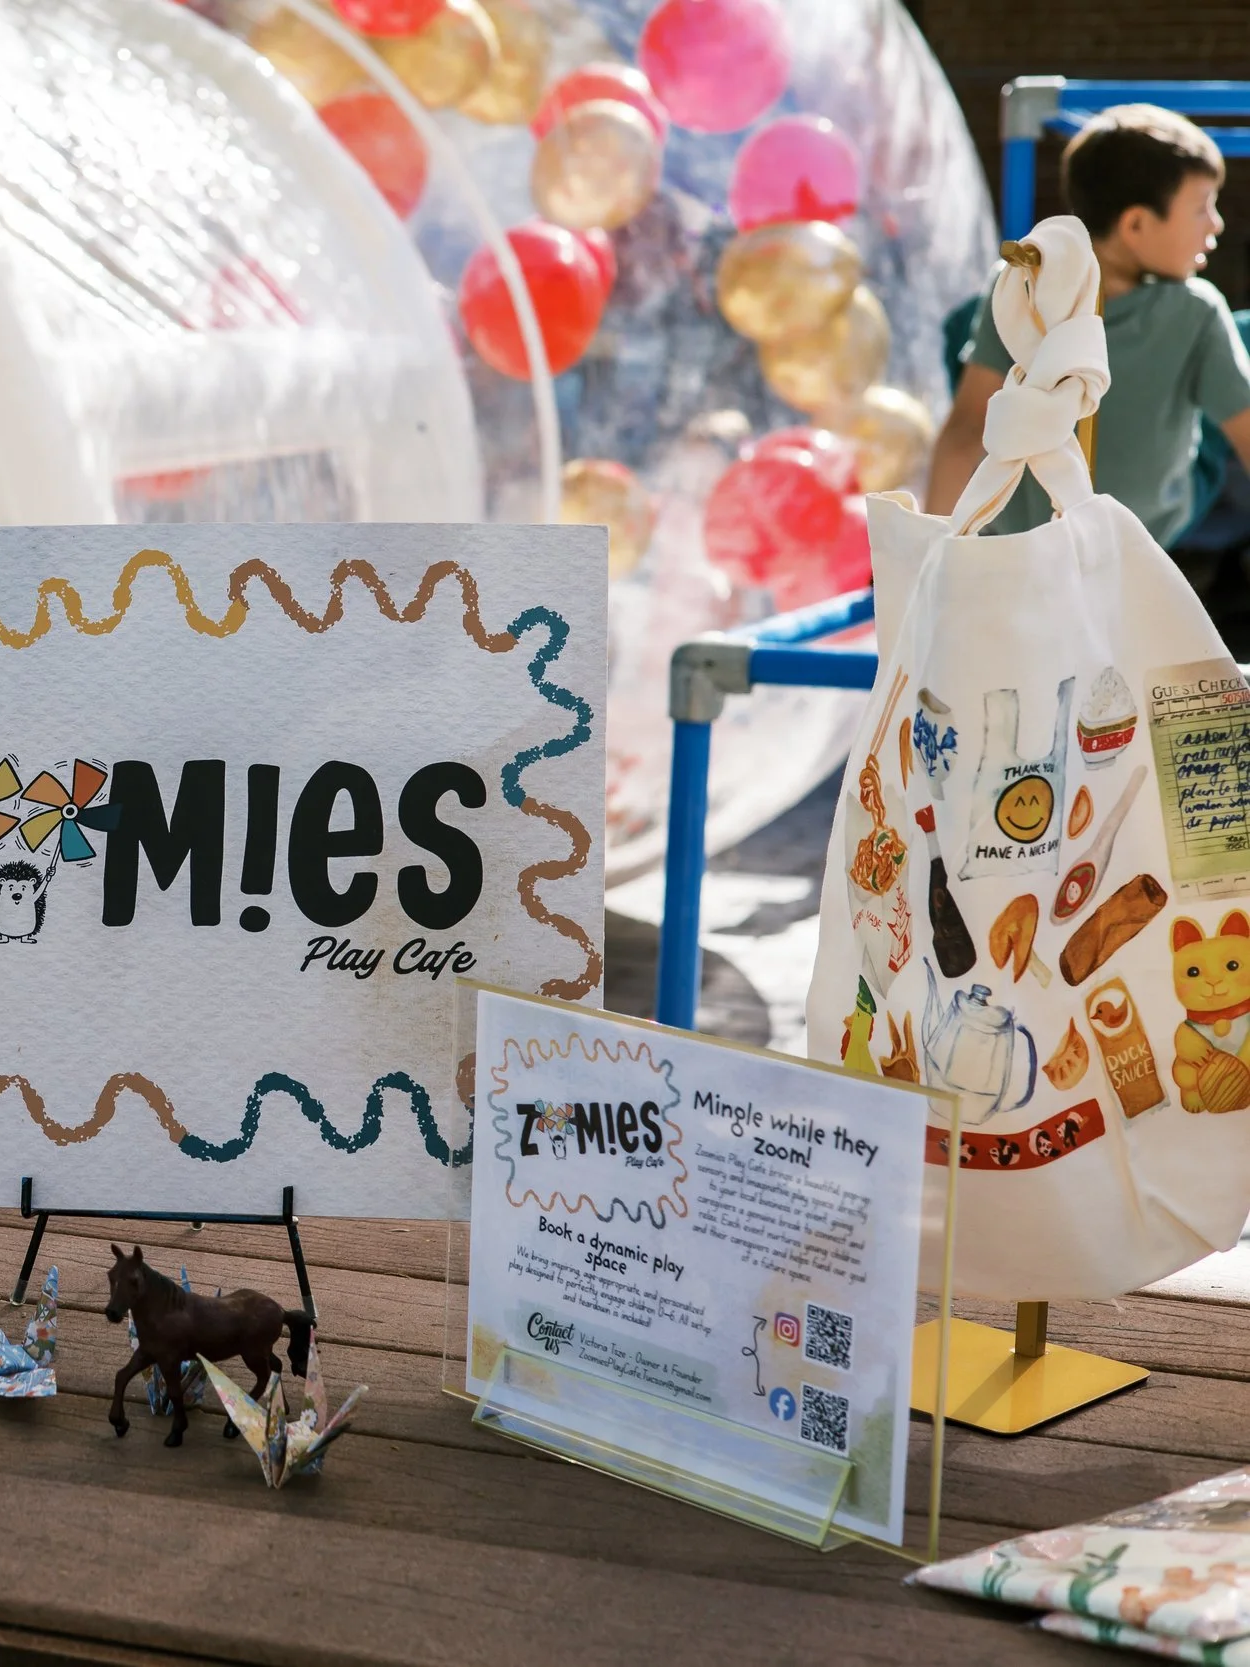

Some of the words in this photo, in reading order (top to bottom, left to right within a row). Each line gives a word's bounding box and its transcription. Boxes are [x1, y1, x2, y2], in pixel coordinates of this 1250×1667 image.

[1004, 763, 1041, 781] THANK
[975, 844, 1013, 859] HAVE
[1017, 846, 1026, 858] A
[1029, 842, 1046, 857] NICE
[300, 935, 386, 980] Play
[392, 937, 477, 981] Cafe
[1106, 1041, 1149, 1072] DUCK
[1112, 1057, 1155, 1090] SAUCE
[693, 1090, 763, 1138] Mingle
[770, 1113, 826, 1145] while
[832, 1125, 879, 1168] they
[753, 1136, 812, 1168] zoom!
[538, 1215, 573, 1242] Book
[577, 1233, 585, 1244] a
[589, 1232, 649, 1264] dynamic
[652, 1253, 684, 1282] play
[584, 1252, 627, 1275] space
[508, 1258, 524, 1276] play
[525, 1262, 555, 1282] designed
[556, 1275, 564, 1285] to
[564, 1279, 599, 1301] perfectly
[600, 1292, 626, 1309] engage
[628, 1296, 656, 1315] children
[516, 1244, 529, 1258] We
[531, 1249, 549, 1270] bring
[643, 1290, 658, 1301] and
[562, 1292, 577, 1303] and
[578, 1294, 611, 1315] teardown
[527, 1311, 575, 1341] Contact
[635, 1351, 661, 1370] Owner
[671, 1363, 703, 1384] Founder
